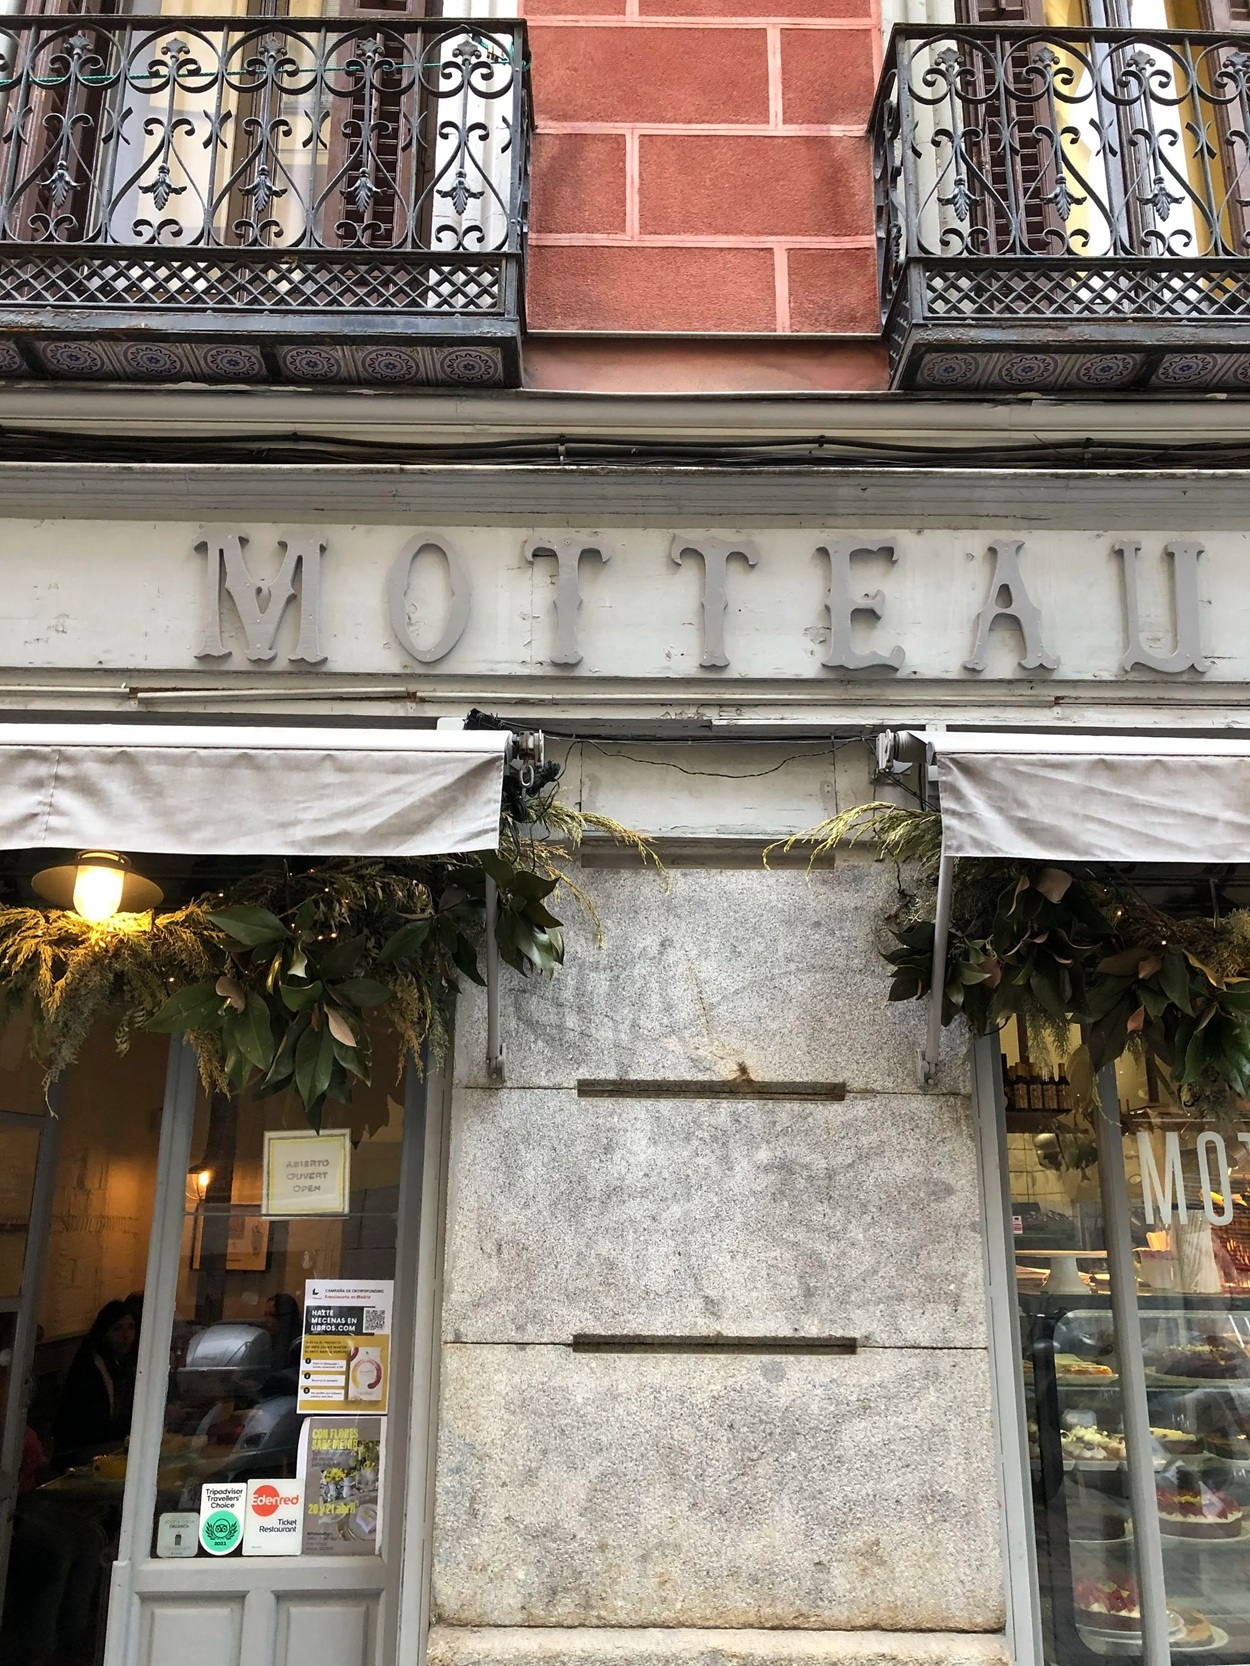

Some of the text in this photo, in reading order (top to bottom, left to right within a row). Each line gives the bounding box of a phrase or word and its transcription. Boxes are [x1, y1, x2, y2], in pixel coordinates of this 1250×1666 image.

[194, 531, 1211, 674] MOTTEAU
[286, 1160, 330, 1168] ABIERTO
[286, 1172, 328, 1180] OUVERT
[312, 1428, 359, 1439] CON FLORES
[252, 1495, 299, 1505] Edenred
[308, 1504, 318, 1514] 20
[336, 1502, 355, 1514] abril
